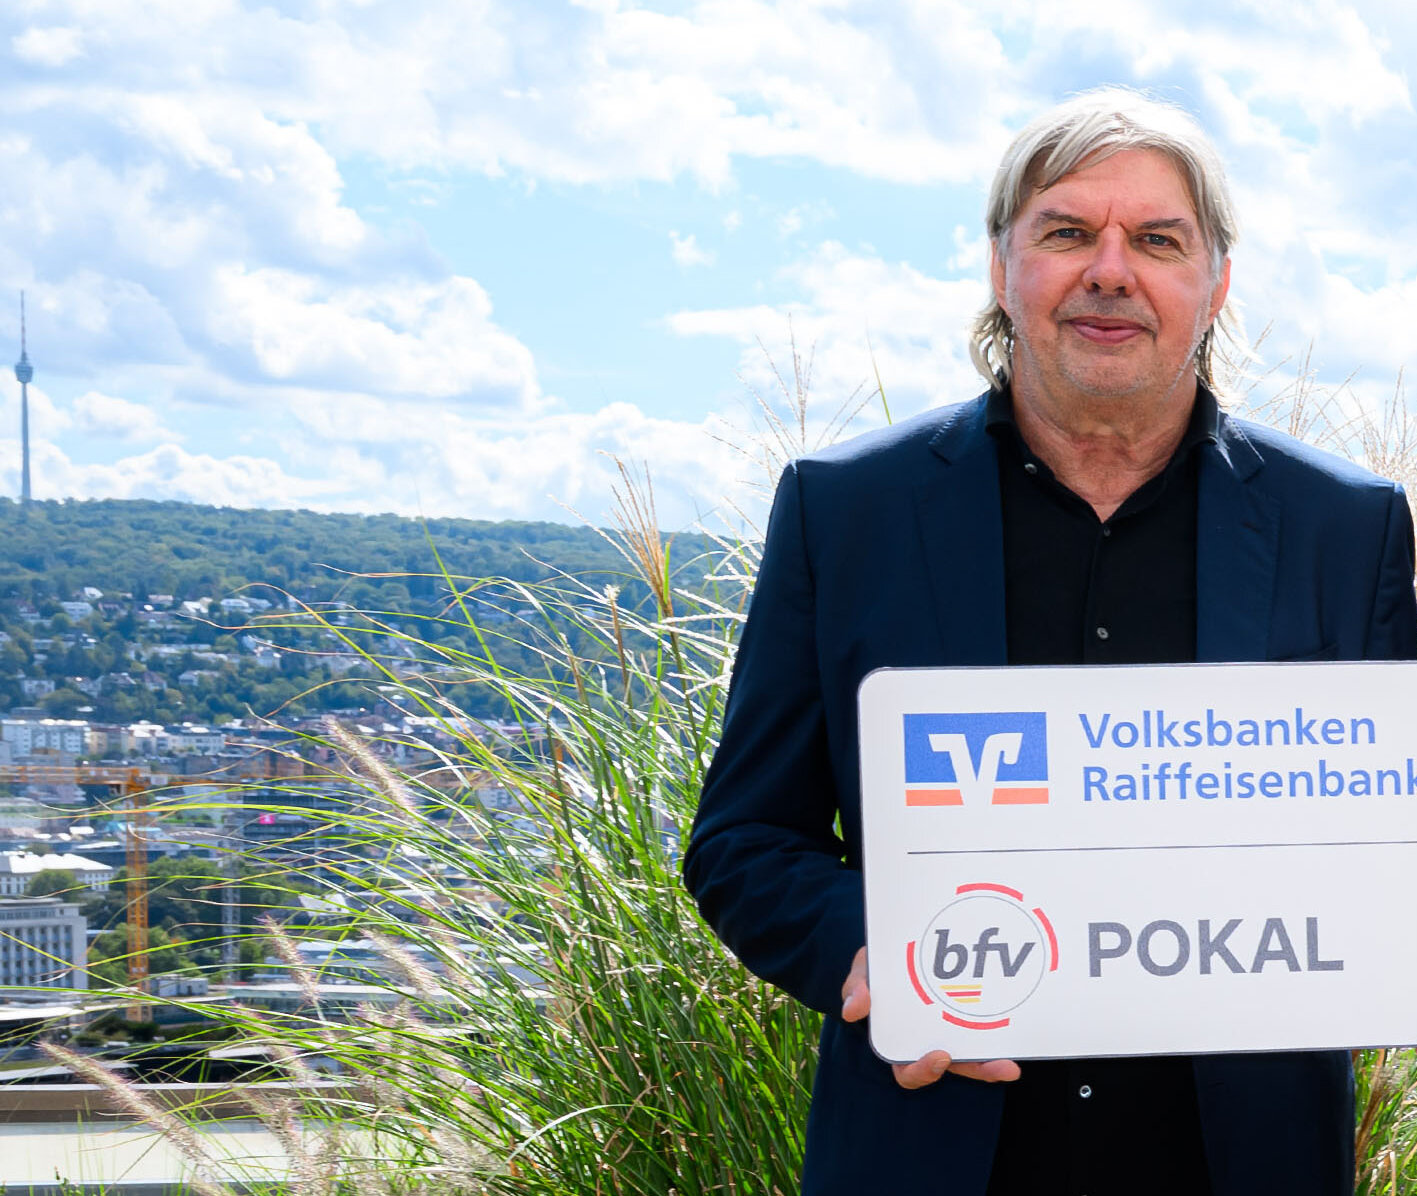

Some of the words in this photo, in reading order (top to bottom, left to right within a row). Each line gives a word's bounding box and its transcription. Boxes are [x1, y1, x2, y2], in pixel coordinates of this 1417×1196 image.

[1079, 708, 1376, 749] Volksbanken
[932, 928, 1036, 981] bfv
[1088, 915, 1345, 978] POKAL
